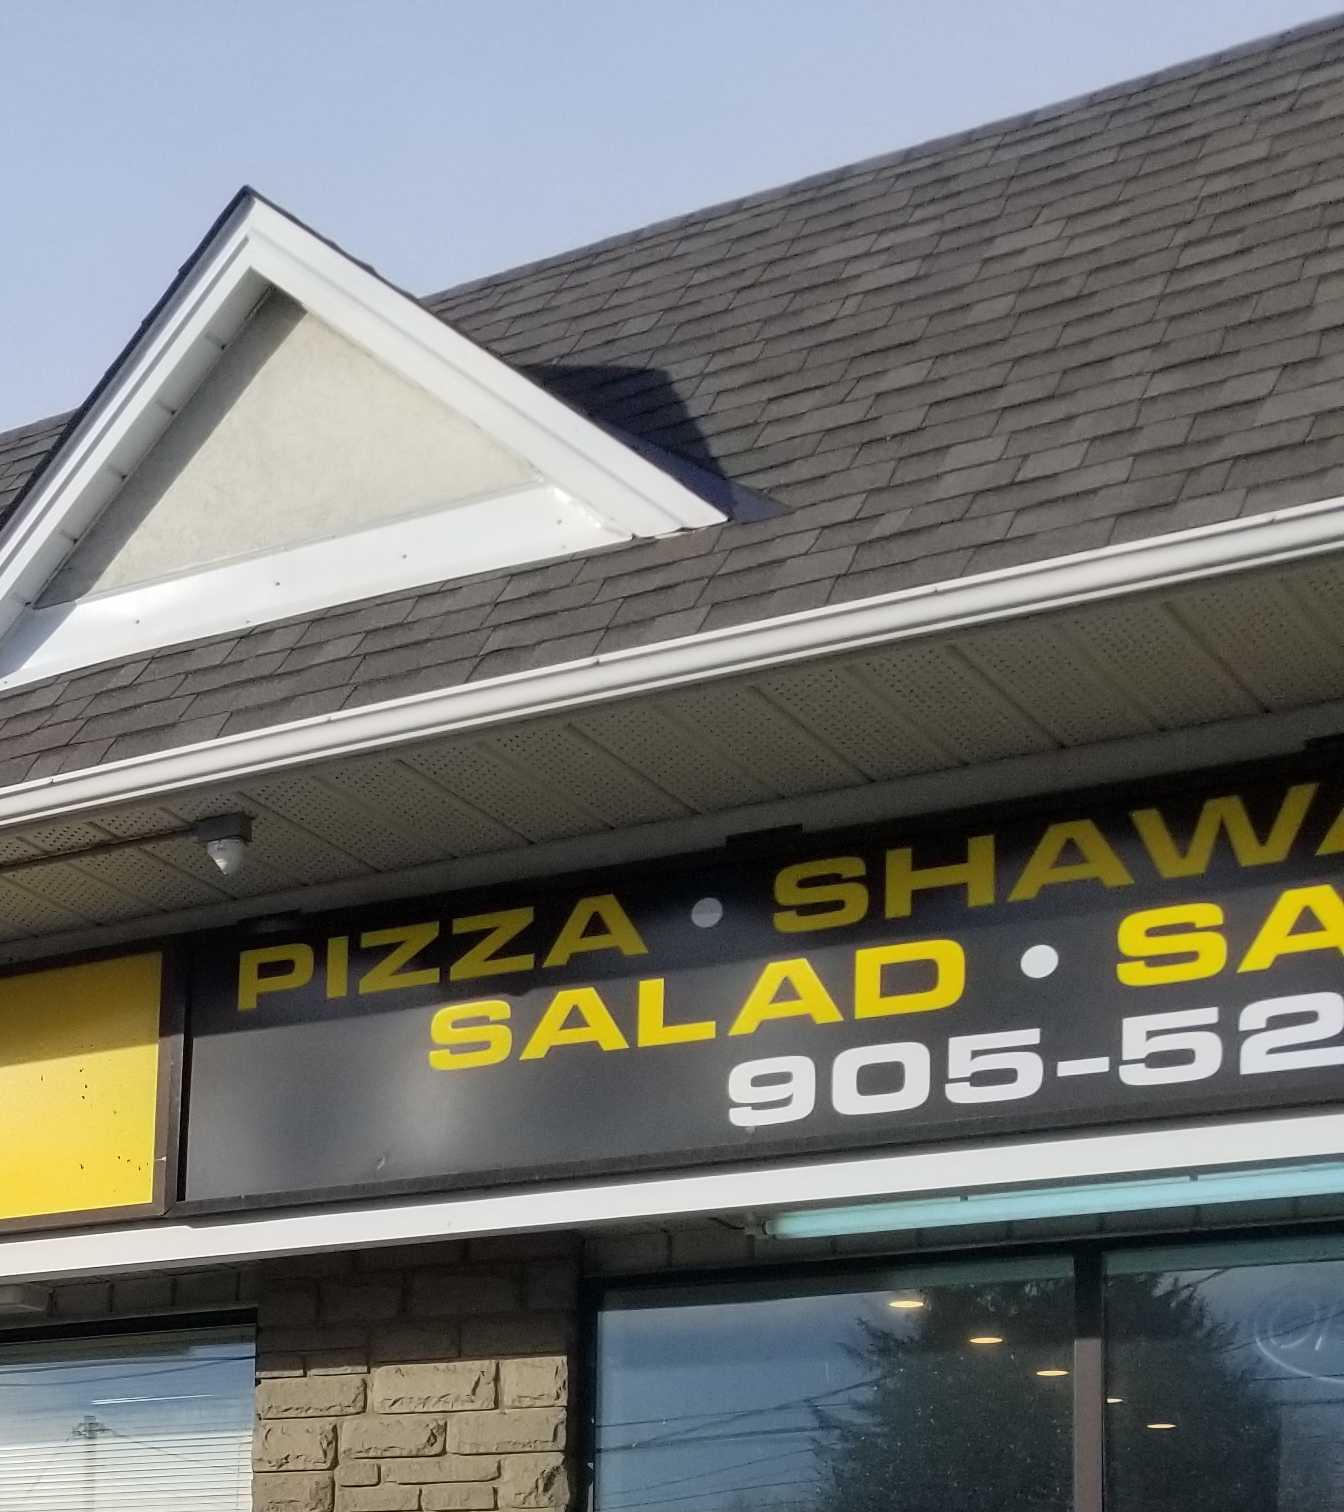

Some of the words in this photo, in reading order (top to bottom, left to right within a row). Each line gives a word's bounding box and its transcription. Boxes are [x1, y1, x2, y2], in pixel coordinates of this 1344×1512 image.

[237, 893, 649, 1012] PIZZA
[428, 938, 966, 1071] SALAD
[728, 991, 1344, 1128] 905-52
